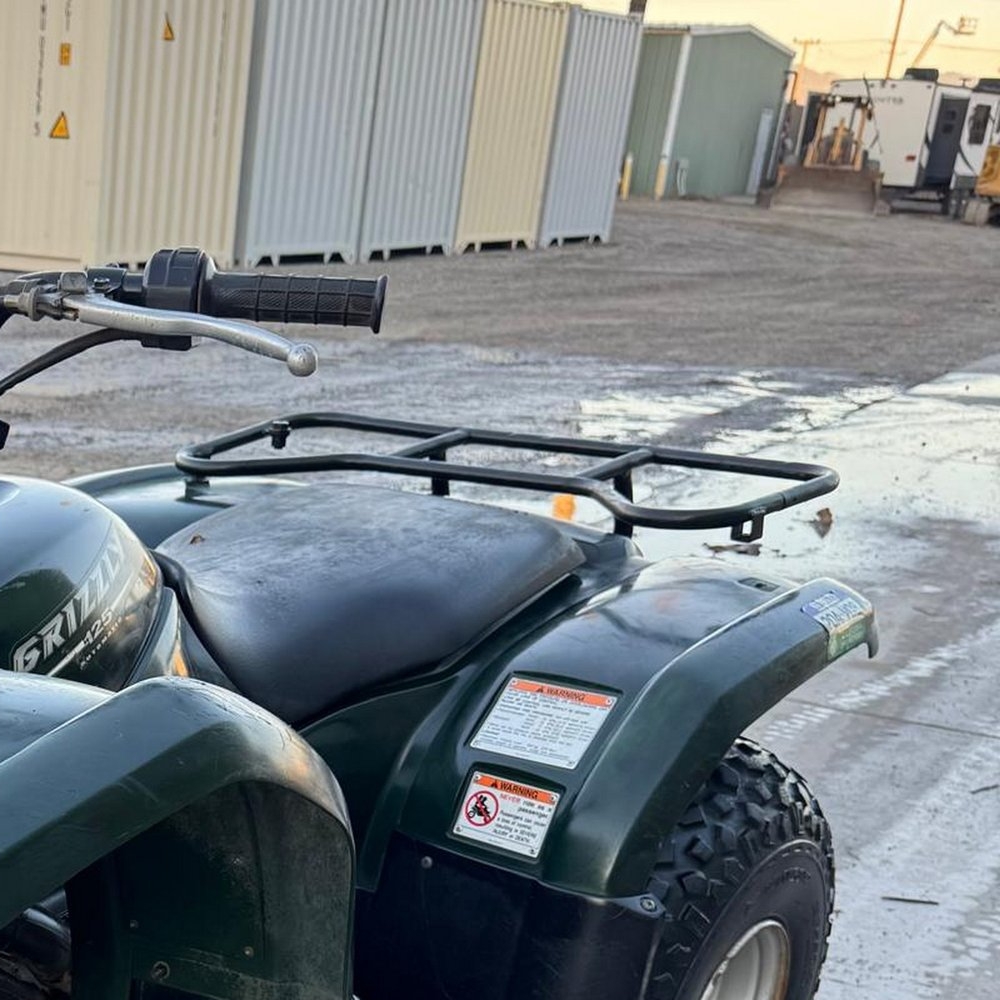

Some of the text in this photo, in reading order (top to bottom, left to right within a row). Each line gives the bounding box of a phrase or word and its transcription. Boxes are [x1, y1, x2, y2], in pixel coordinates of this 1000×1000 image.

[13, 528, 124, 672] GRIZZLY
[84, 608, 113, 645] 125
[547, 686, 586, 701] WARNING
[501, 781, 539, 799] WARNING
